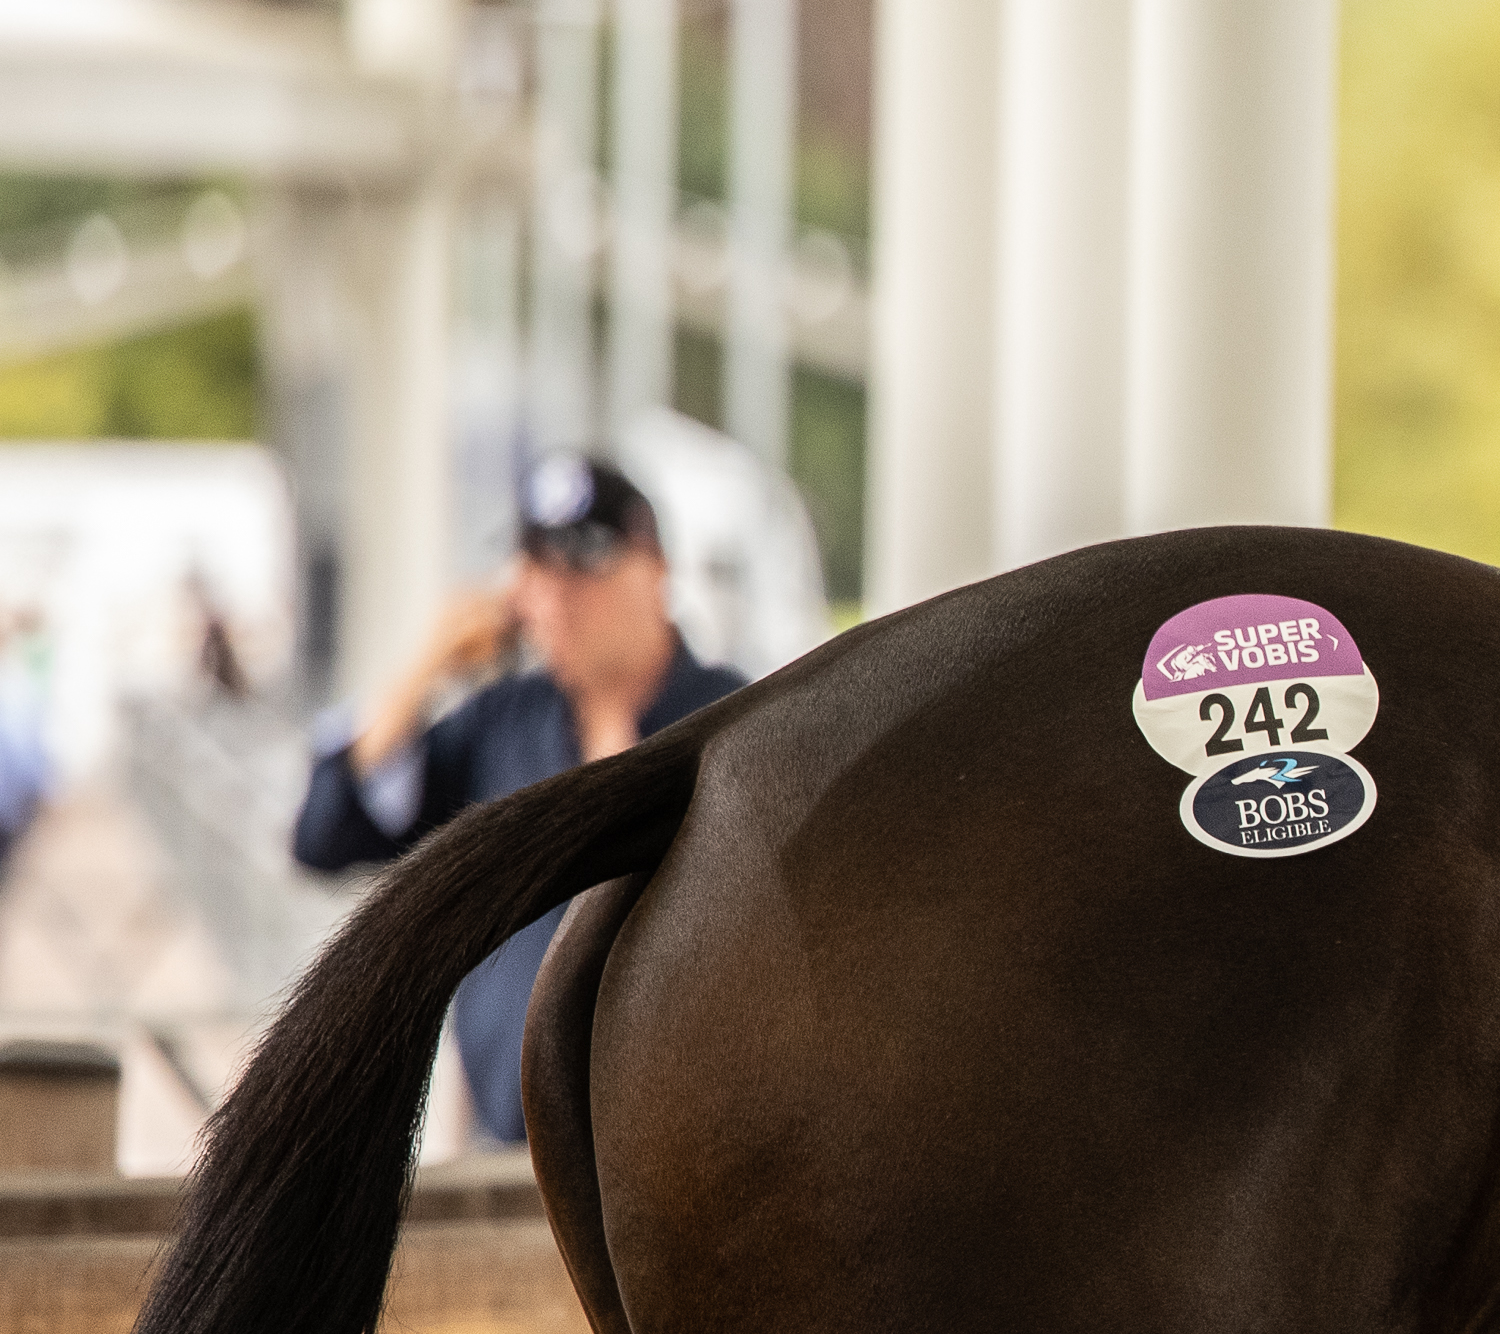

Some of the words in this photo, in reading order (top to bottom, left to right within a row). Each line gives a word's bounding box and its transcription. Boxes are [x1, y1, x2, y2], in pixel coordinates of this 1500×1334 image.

[1213, 617, 1323, 652] SUPER
[1217, 639, 1320, 672] VOBIS
[1198, 682, 1330, 758] 242
[1234, 788, 1330, 829] BOBS
[1240, 819, 1332, 846] ELIGIBLE
